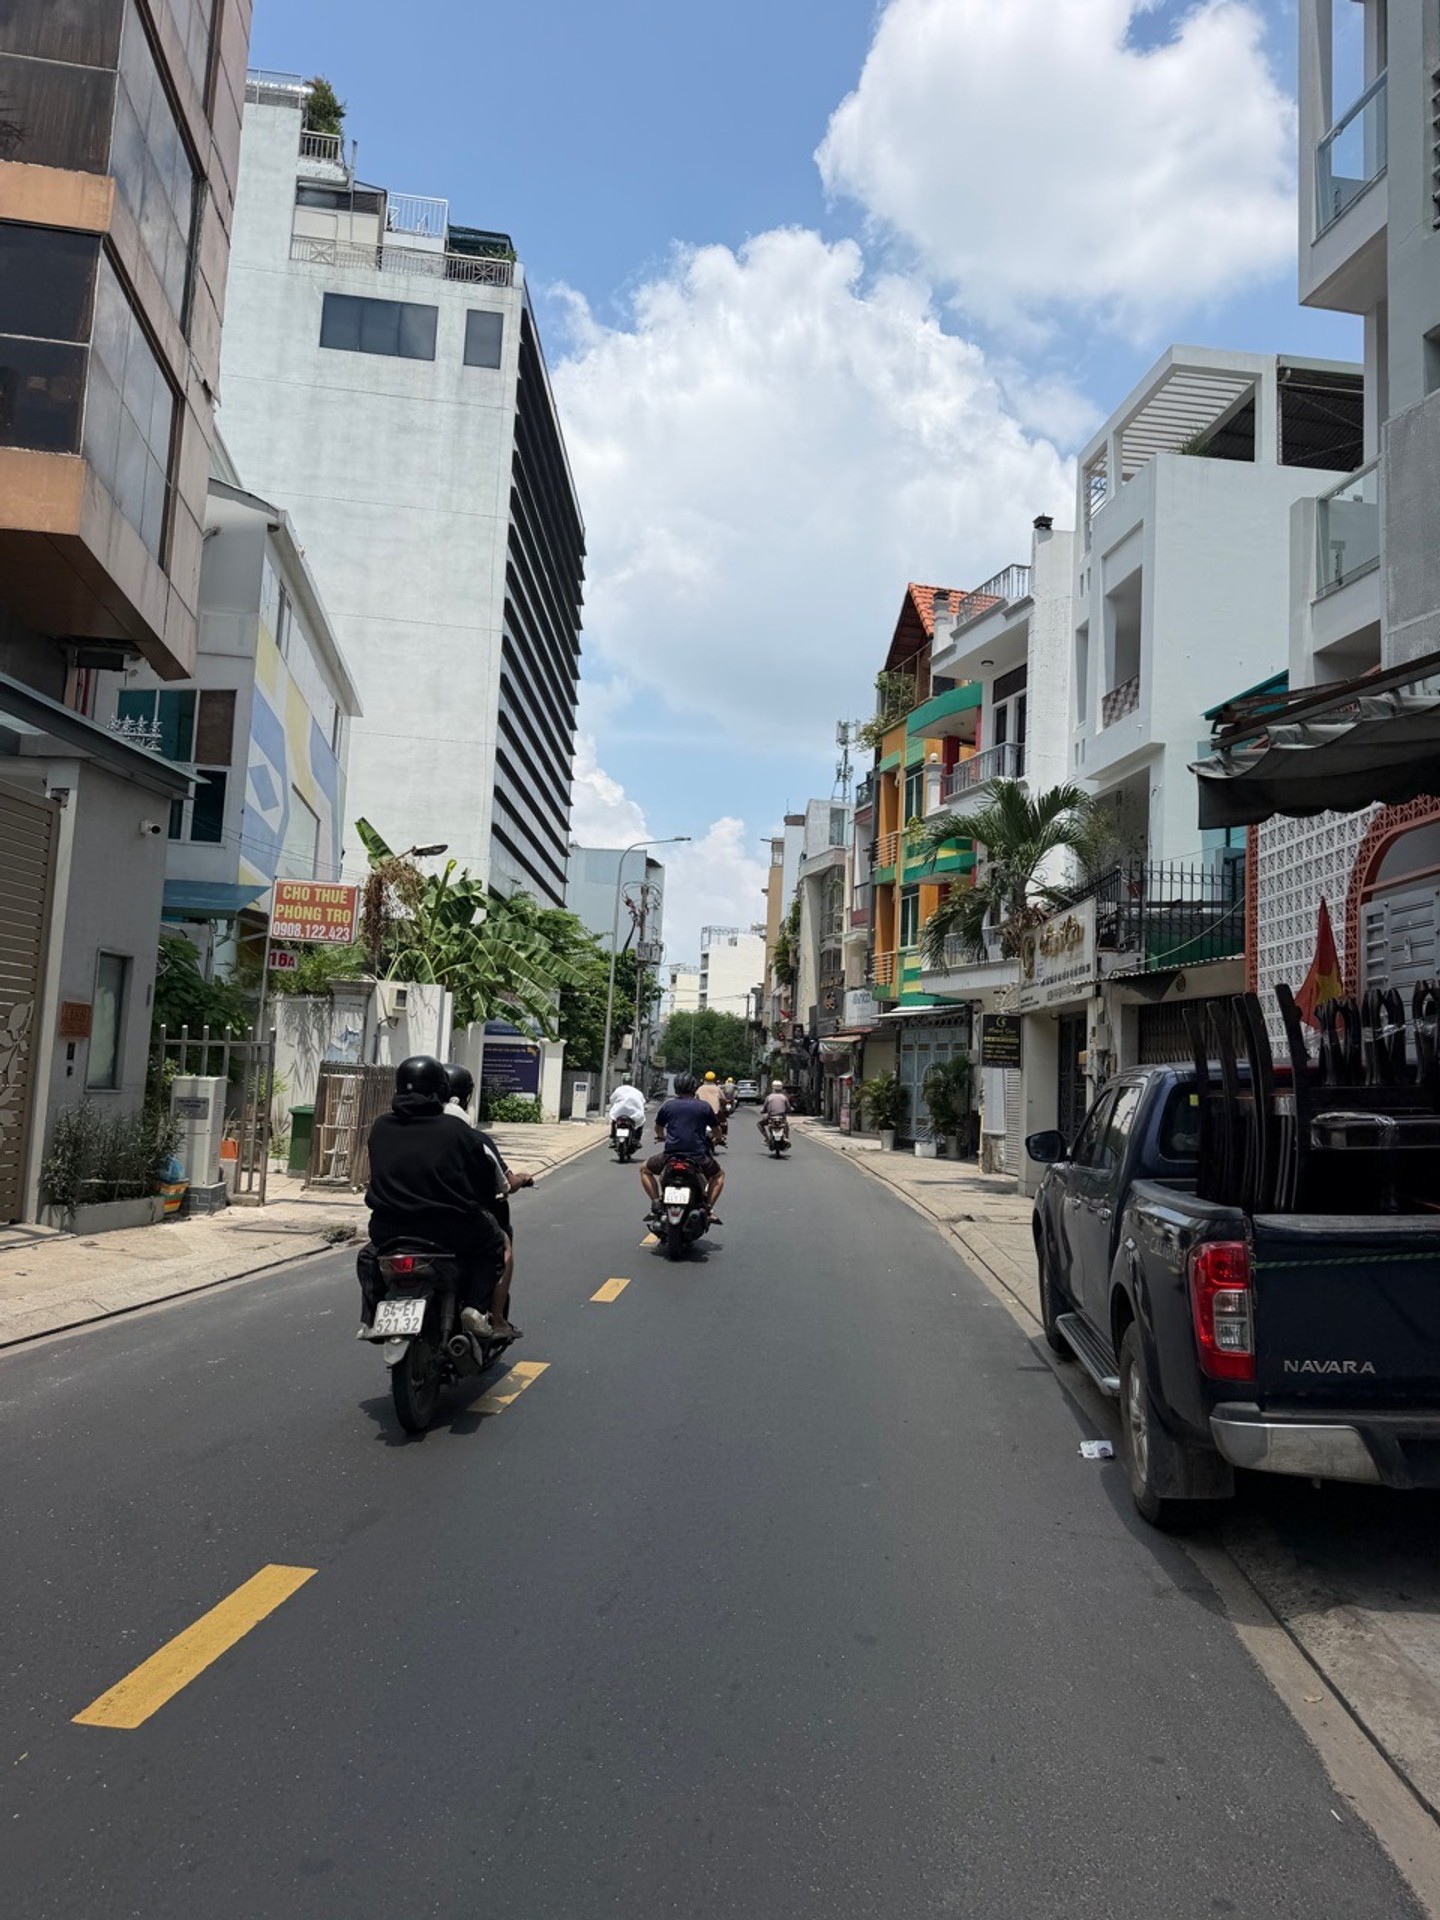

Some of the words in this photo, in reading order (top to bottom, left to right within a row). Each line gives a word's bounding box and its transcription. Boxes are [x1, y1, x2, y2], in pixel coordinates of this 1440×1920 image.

[282, 885, 310, 901] CHO
[314, 887, 348, 904] THUÊ
[274, 902, 322, 921] PHÒNG
[326, 908, 352, 926] TRỌ
[272, 921, 351, 941] 0908.122.423
[270, 951, 296, 968] 16A
[376, 1317, 420, 1333] 521.32
[1283, 1360, 1376, 1374] NAVARA
